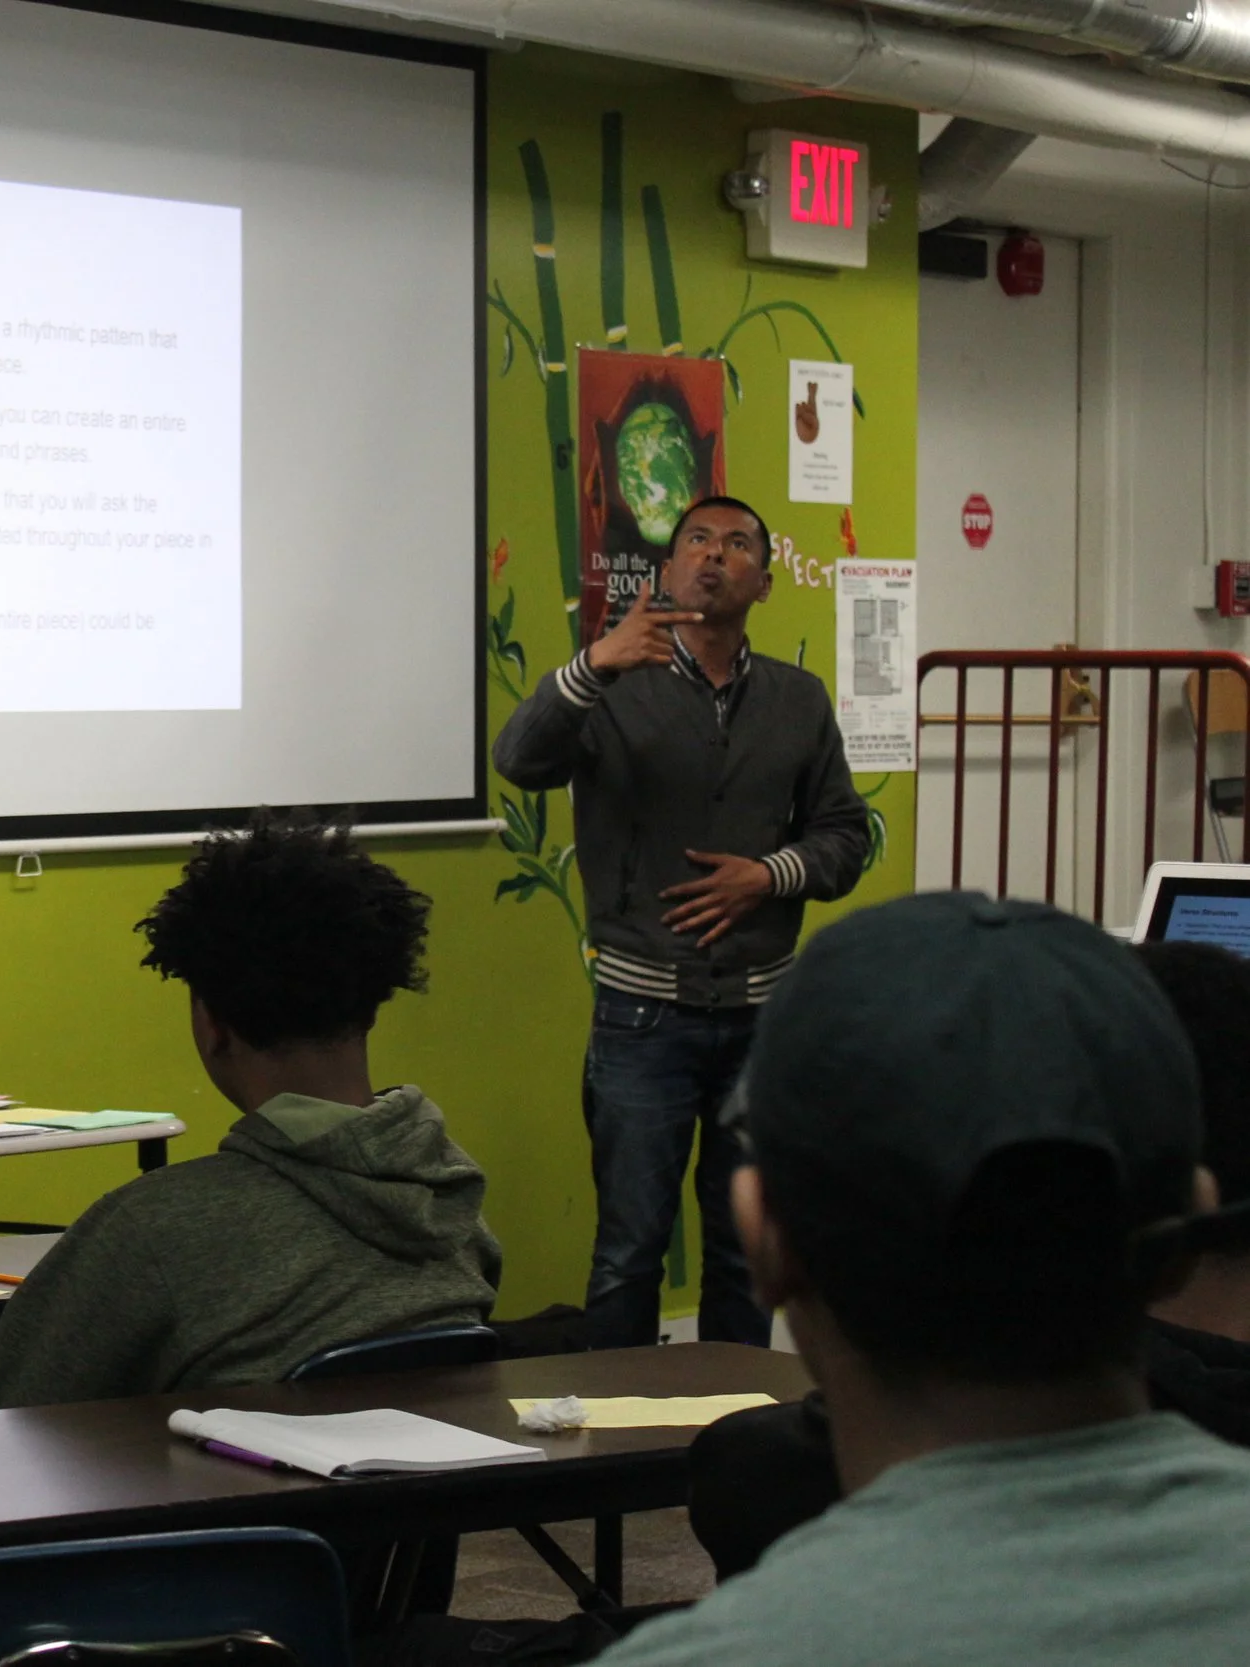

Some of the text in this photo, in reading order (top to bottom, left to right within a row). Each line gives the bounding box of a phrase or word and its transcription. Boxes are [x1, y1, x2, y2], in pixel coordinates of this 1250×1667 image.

[791, 140, 860, 230] EXIT
[3, 321, 12, 338] a
[18, 317, 85, 345] rhythmic
[90, 325, 144, 348] pattern
[149, 328, 178, 349] that
[31, 407, 60, 426] can
[66, 409, 115, 429] create
[119, 413, 138, 431] an
[142, 412, 187, 432] entire
[25, 442, 93, 465] phrases.
[3, 491, 35, 510] that
[39, 496, 67, 515] you
[71, 491, 97, 512] will
[101, 493, 128, 513] ask
[133, 493, 158, 514] the
[26, 528, 112, 551] throughout
[115, 532, 150, 552] your
[154, 533, 194, 552] piece
[199, 532, 213, 549] in
[592, 553, 649, 571] Do all the
[770, 532, 835, 588] SPECT
[841, 567, 889, 577] EVACUATION
[606, 565, 656, 603] good
[36, 610, 85, 633] piece)
[89, 610, 131, 630] could
[135, 610, 155, 630] be
